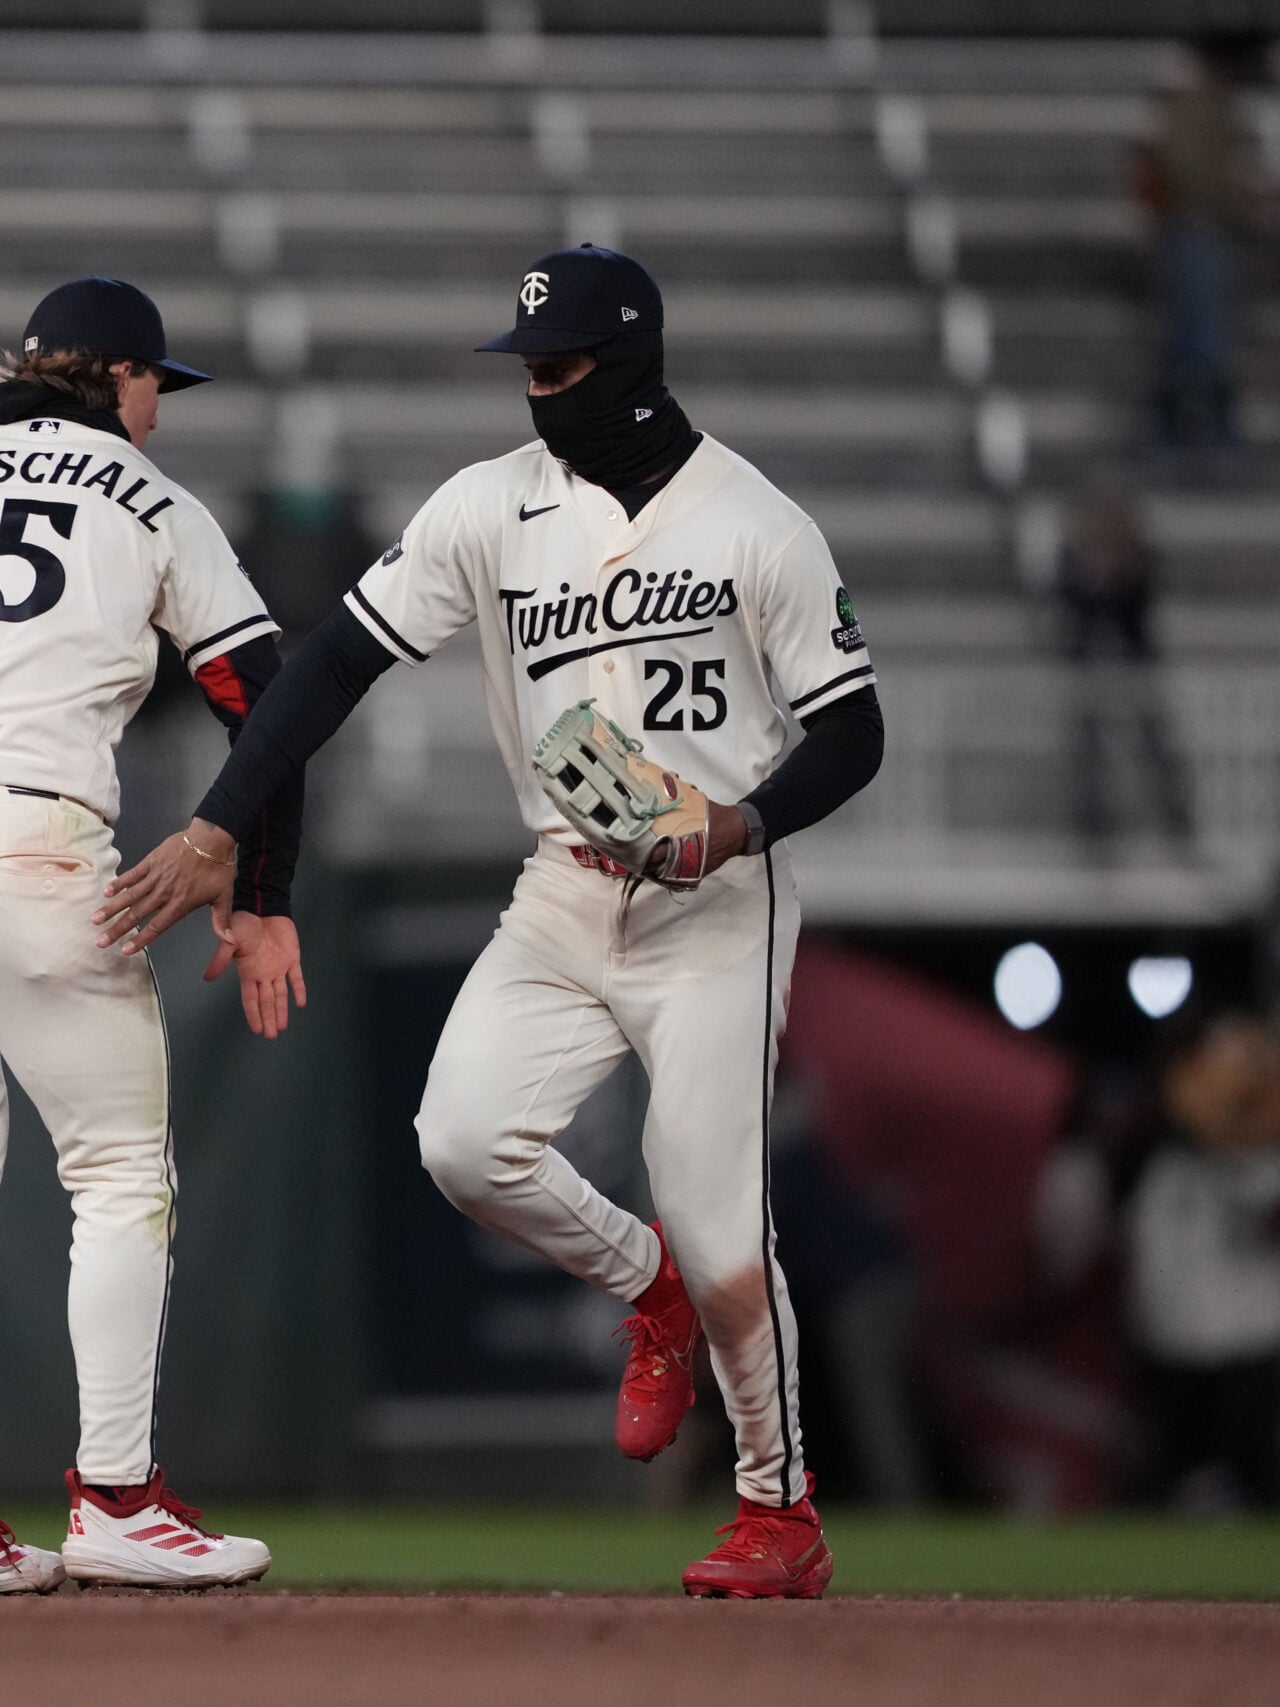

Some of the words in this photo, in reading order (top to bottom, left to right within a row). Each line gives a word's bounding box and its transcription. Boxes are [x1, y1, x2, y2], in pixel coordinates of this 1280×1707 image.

[499, 581, 598, 655] Twin
[602, 568, 738, 632] Cities
[642, 659, 727, 731] 25
